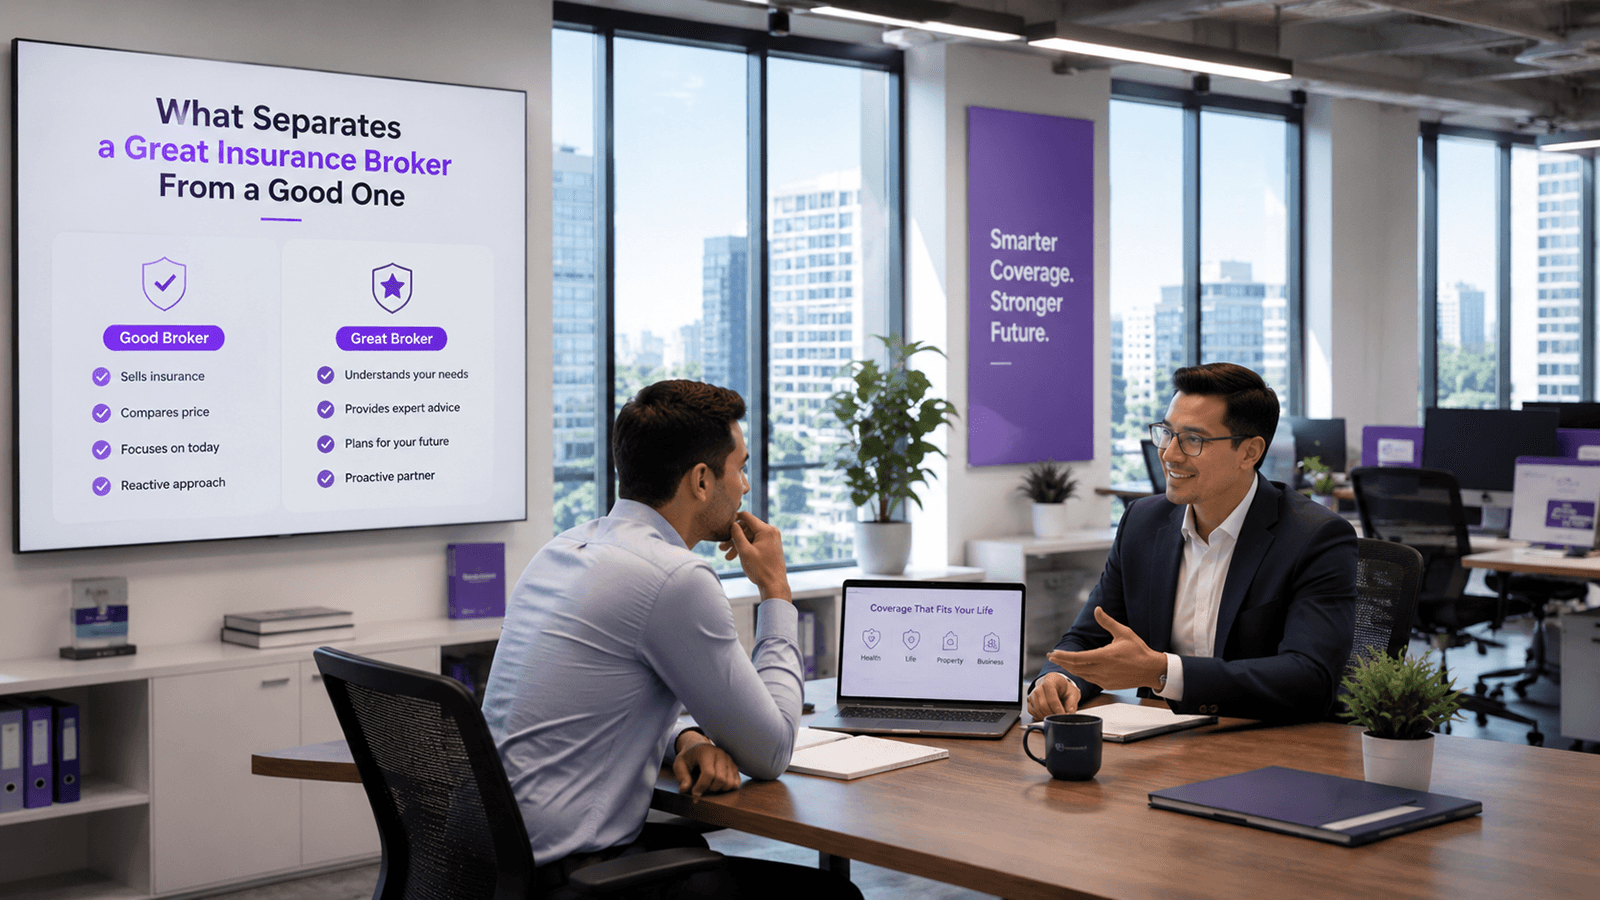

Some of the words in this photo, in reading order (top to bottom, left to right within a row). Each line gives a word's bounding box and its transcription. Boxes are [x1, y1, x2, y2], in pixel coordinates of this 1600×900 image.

[156, 98, 243, 129] What
[254, 105, 401, 139] Separates
[98, 140, 114, 158] a
[125, 135, 208, 163] Great
[219, 140, 356, 171] Insurance
[365, 149, 452, 176] Broker
[160, 173, 234, 199] From
[244, 183, 259, 200] a
[269, 178, 342, 204] Good
[352, 182, 405, 206] One
[991, 228, 1057, 251] Smarter
[990, 259, 1074, 287] Coverage.
[990, 290, 1063, 317] Stronger
[120, 332, 158, 344] Good
[163, 332, 209, 344] Broker
[351, 333, 387, 344] Great
[391, 333, 433, 344] Broker
[991, 322, 1049, 342] Future.
[120, 370, 148, 383] Sells
[150, 370, 206, 382] insurance
[344, 369, 411, 381] Understands
[412, 371, 437, 382] your
[438, 368, 469, 380] needs
[120, 407, 179, 420] Compares
[181, 406, 210, 420] price
[345, 403, 390, 415] Provides
[391, 403, 426, 416] expert
[427, 402, 461, 413] advice
[121, 443, 168, 455] Focuses
[170, 444, 185, 454] on
[187, 441, 220, 455] today
[345, 438, 374, 449] Plans
[375, 437, 392, 448] for
[392, 438, 417, 450] your
[418, 436, 450, 447] future
[121, 479, 171, 491] Reactive
[172, 476, 226, 492] approach
[345, 471, 395, 483] Proactive
[396, 471, 436, 484] partner
[870, 604, 912, 614] Coverage
[915, 605, 934, 613] That
[937, 605, 952, 613] Fits
[955, 606, 974, 614] Your
[977, 606, 993, 615] Life
[937, 657, 964, 665] Property
